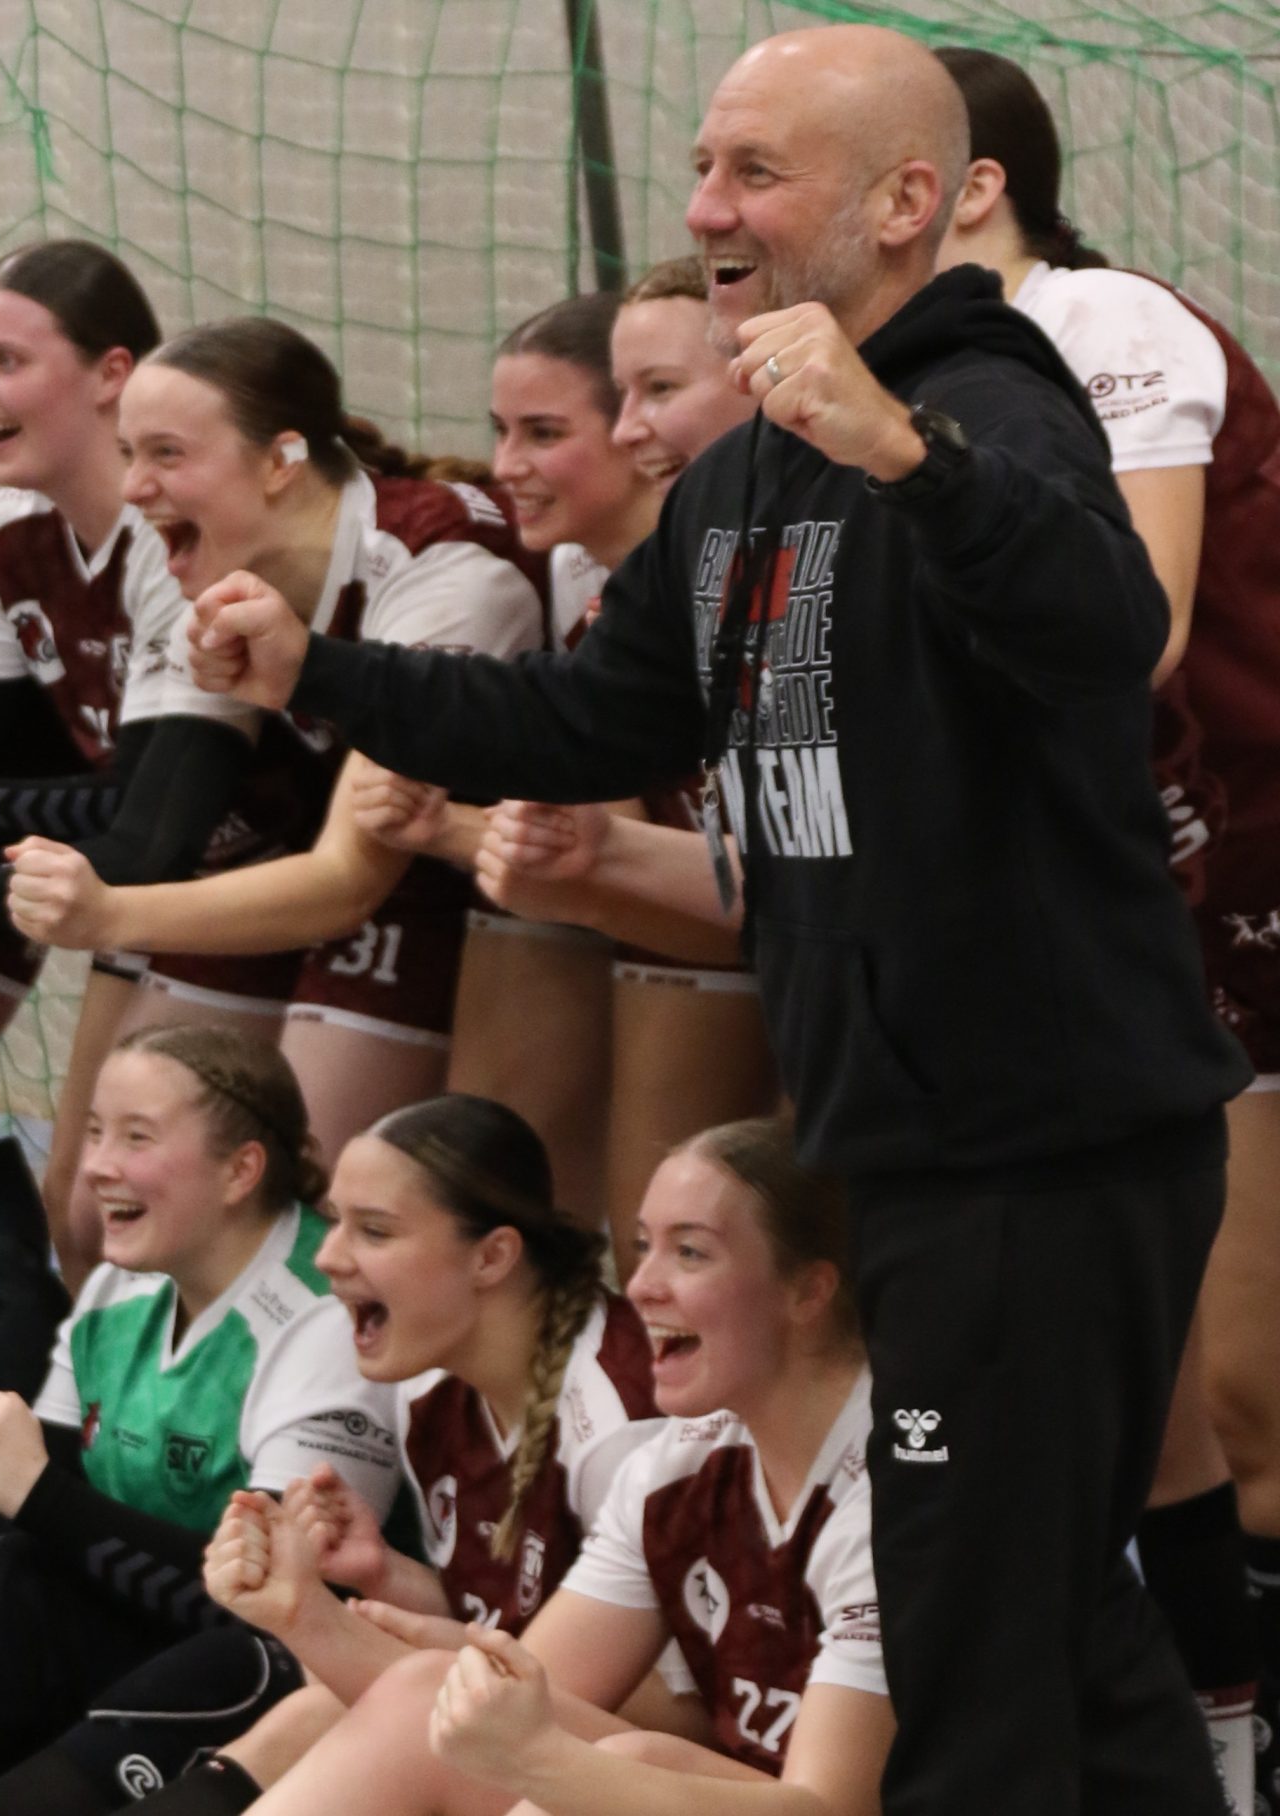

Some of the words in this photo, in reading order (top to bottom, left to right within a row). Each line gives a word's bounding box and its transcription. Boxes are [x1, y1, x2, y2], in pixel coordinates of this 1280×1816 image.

[329, 920, 402, 983] 31
[894, 1442, 949, 1462] hummel
[732, 1677, 801, 1752] 27
